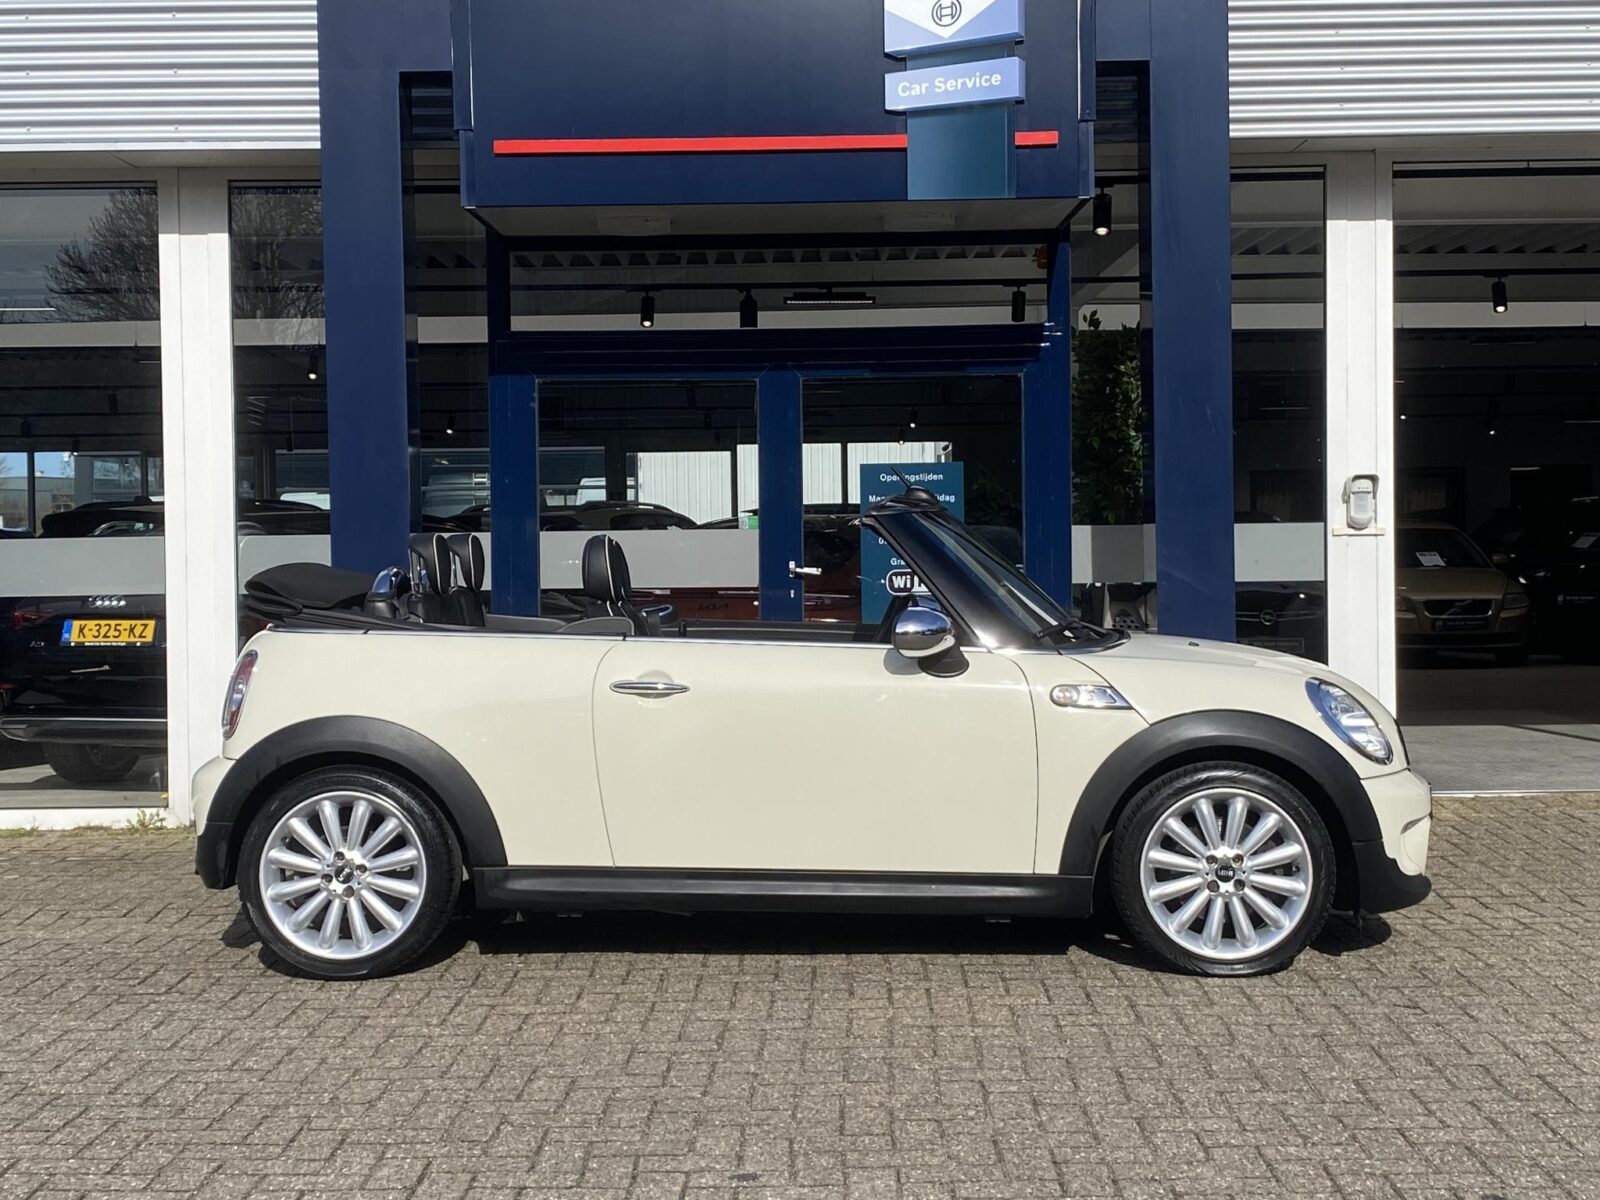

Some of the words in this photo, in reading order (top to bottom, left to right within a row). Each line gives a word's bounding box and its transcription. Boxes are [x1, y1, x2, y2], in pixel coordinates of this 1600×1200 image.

[898, 81, 929, 97] Car
[934, 72, 1002, 93] Service
[77, 623, 149, 639] K-325-KZ
